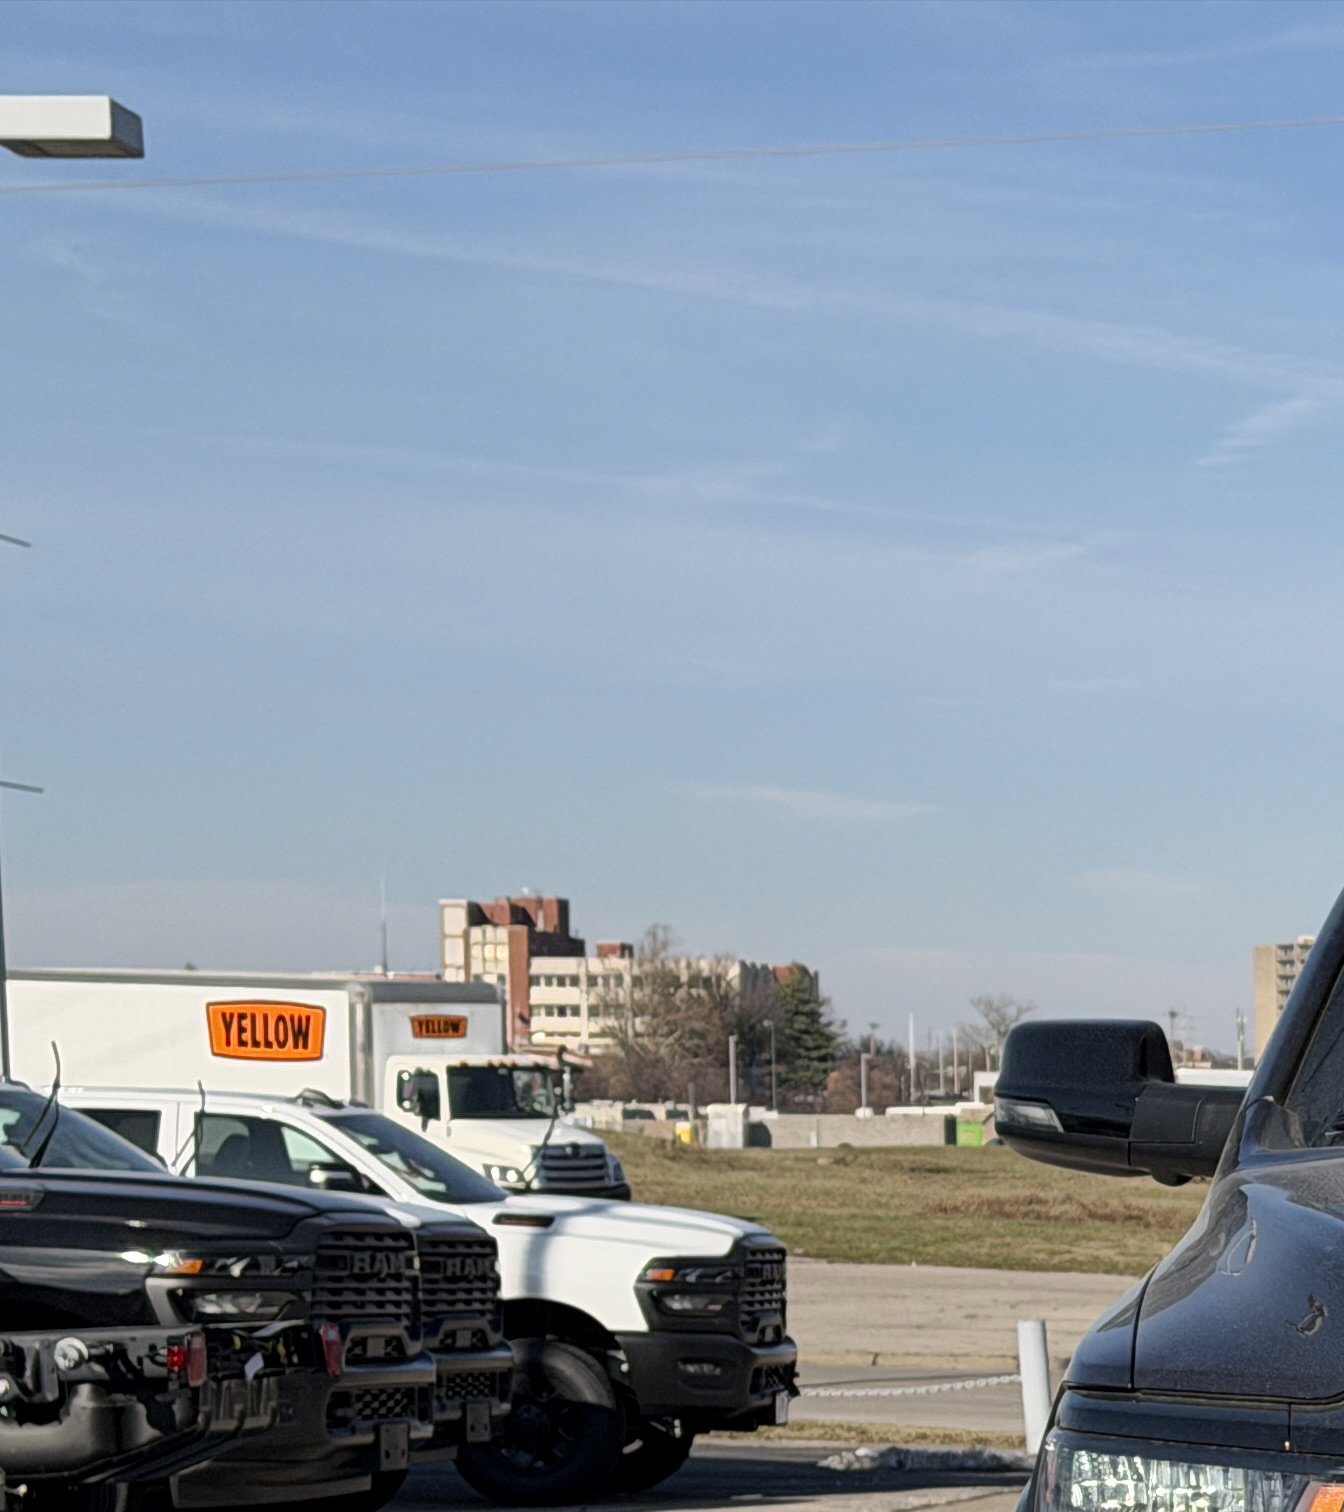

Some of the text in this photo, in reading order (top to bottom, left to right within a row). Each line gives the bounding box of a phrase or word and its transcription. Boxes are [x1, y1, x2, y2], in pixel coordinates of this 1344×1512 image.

[221, 1012, 311, 1050] YELLOW
[417, 1020, 460, 1034] YELLOW
[352, 1251, 405, 1275] RAM
